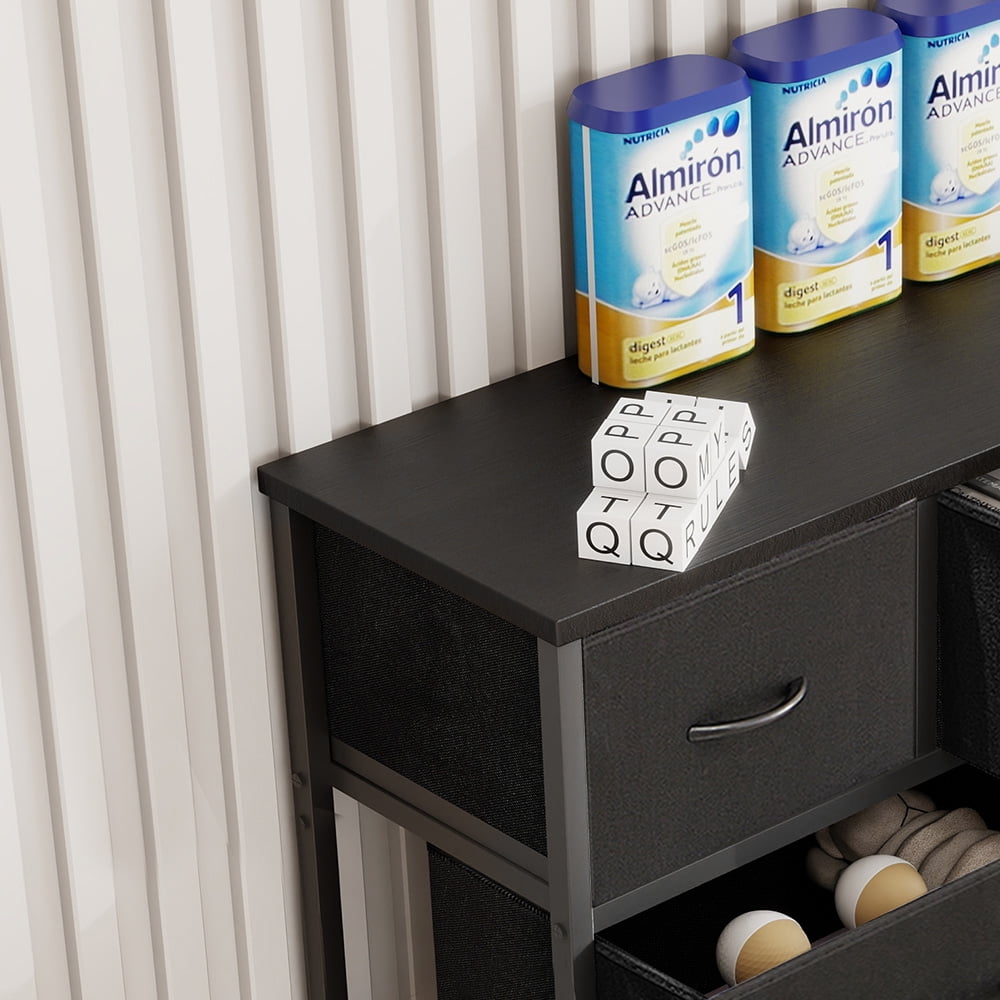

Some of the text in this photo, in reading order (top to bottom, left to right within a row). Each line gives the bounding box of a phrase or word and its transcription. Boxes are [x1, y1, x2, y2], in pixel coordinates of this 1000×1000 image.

[927, 31, 970, 49] NUTRICIA
[782, 77, 827, 95] NUTRICIA
[623, 127, 670, 146] NUTRICIA
[783, 98, 893, 152] Almirón
[782, 132, 865, 168] ADVANCE
[625, 148, 742, 203] Almirón
[625, 182, 711, 220] ADVANCE
[878, 229, 892, 271] 1
[926, 232, 959, 249] digest
[728, 281, 743, 324] 1
[784, 282, 819, 300] digest
[629, 336, 666, 355] digest
[586, 522, 674, 565] Q Q
